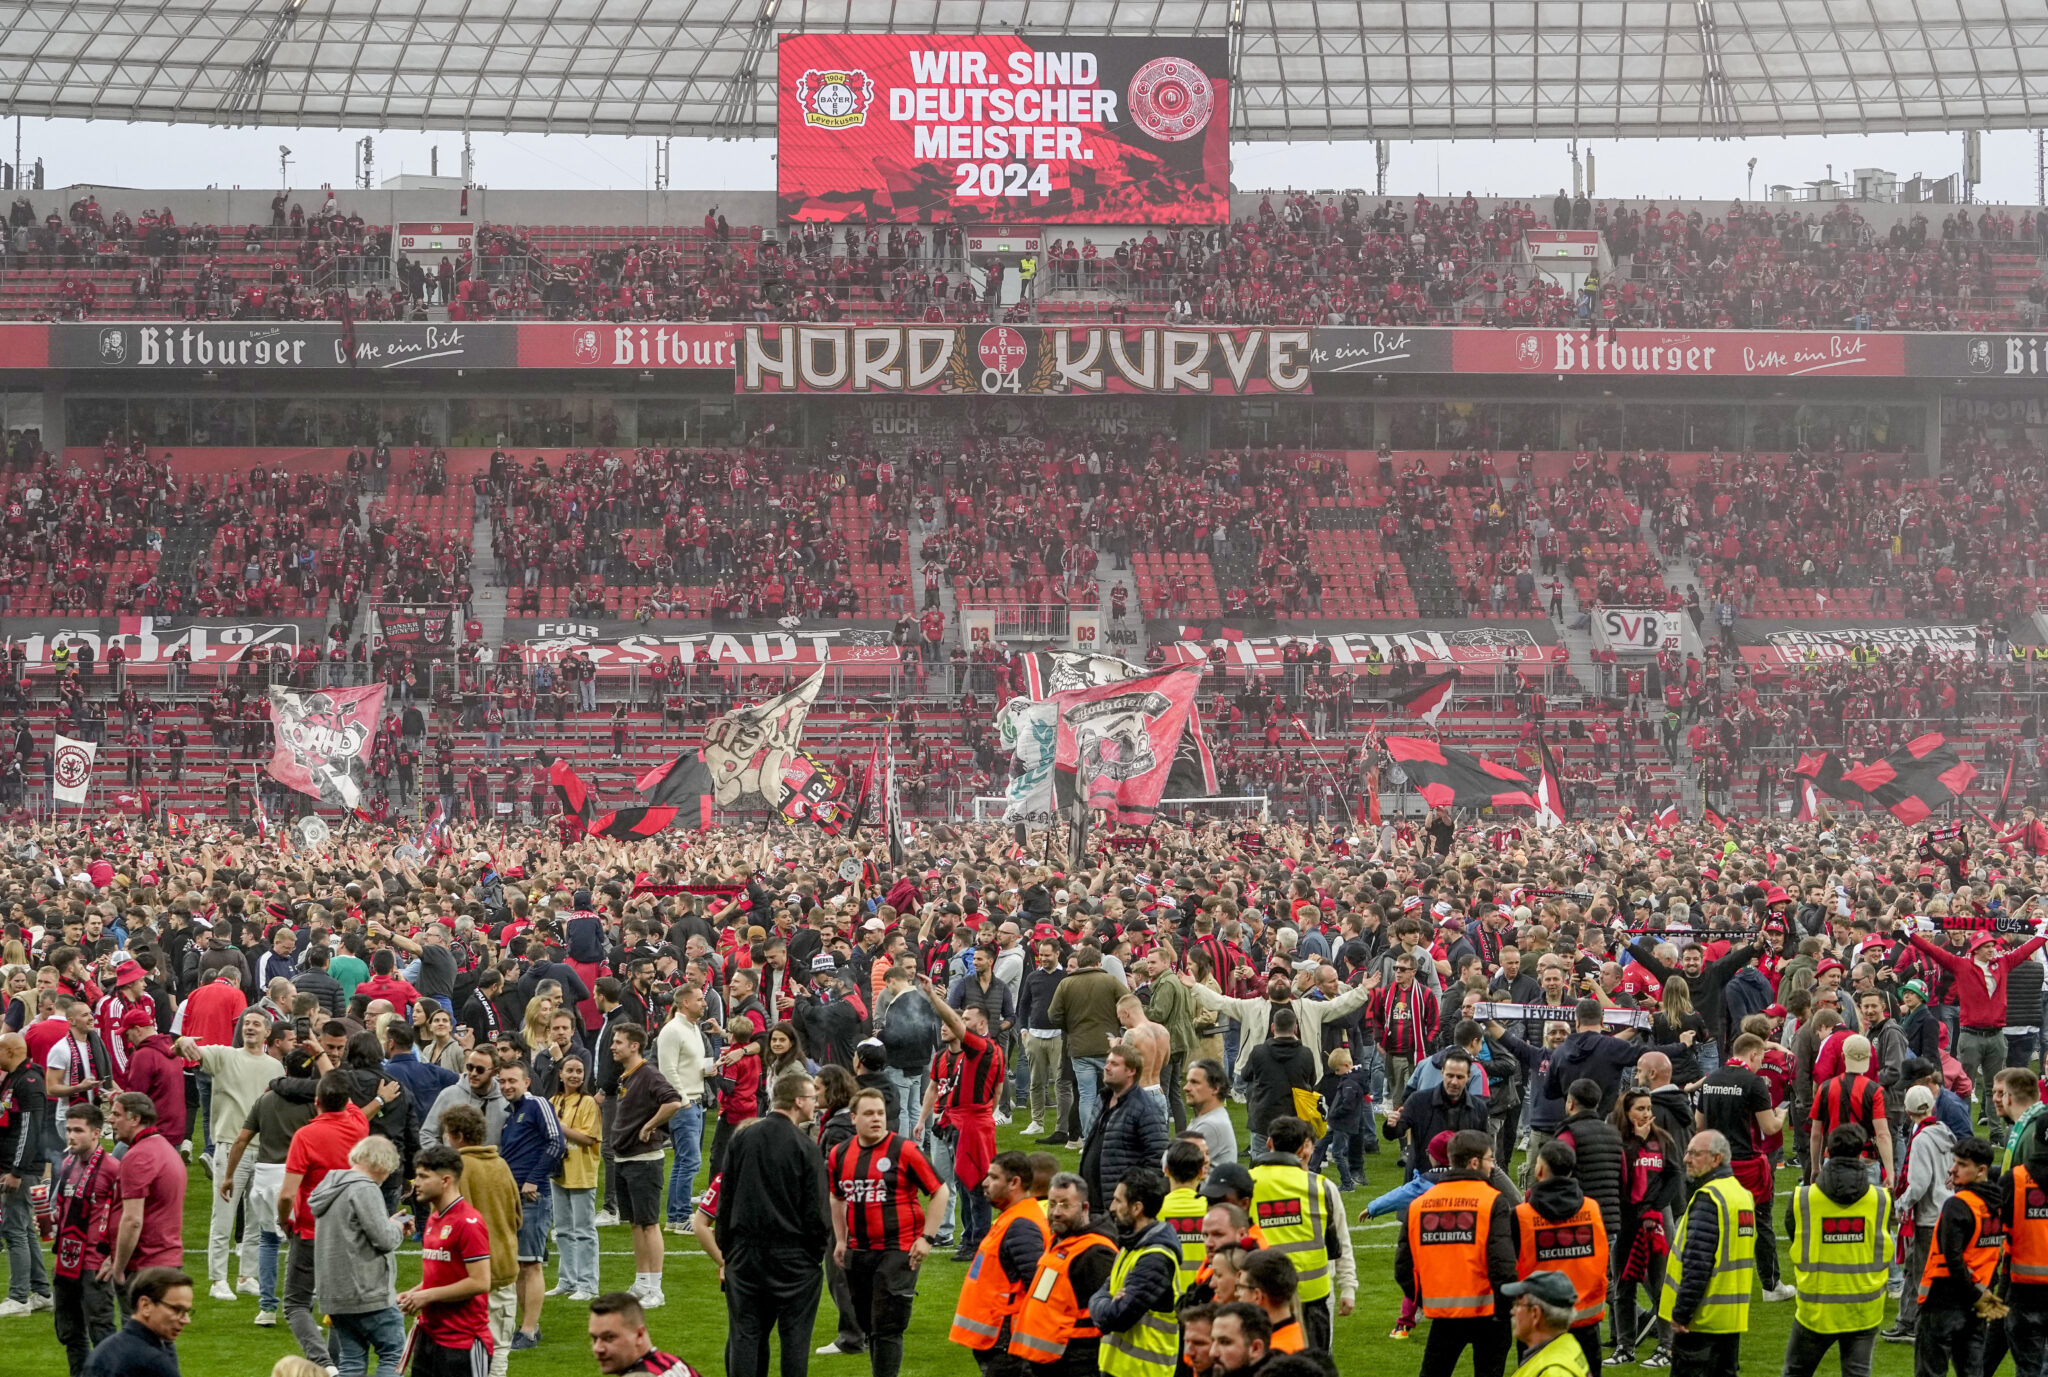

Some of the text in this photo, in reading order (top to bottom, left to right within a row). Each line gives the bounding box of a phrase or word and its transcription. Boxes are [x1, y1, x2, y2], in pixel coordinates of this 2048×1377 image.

[909, 50, 1098, 86] WIR. SIND
[889, 87, 1118, 123] DEUTSCHER
[811, 115, 859, 126] Leverkusen
[913, 125, 1095, 160] MEISTER.
[955, 162, 1052, 197] 2024
[402, 237, 414, 247] D9
[970, 239, 982, 249] D8
[1026, 240, 1038, 250] D8
[1583, 245, 1595, 255] D7
[137, 327, 306, 365] Bitburger
[387, 339, 423, 355] ein
[980, 345, 1026, 355] BAYER
[998, 329, 1008, 372] BAYER
[1335, 344, 1370, 358] ein
[1373, 331, 1410, 353] Bit
[1554, 332, 1717, 371] Bitburger
[742, 325, 957, 391] NORD
[1054, 328, 1310, 392] KURVE
[1744, 336, 1867, 371] Bitte ein Bit
[981, 368, 1022, 393] 04
[872, 418, 919, 434] EUCH
[538, 622, 599, 638] FÜR
[971, 627, 989, 641] D3
[1078, 626, 1095, 641] D3
[1606, 612, 1658, 647] SVB
[618, 631, 841, 664] STADT
[807, 782, 827, 803] 12
[1702, 1083, 1743, 1096] Barmenia
[1421, 1197, 1448, 1209] SECURITY
[1453, 1197, 1479, 1208] SERVICE
[1260, 1215, 1301, 1227] SECURITAS
[1422, 1231, 1473, 1243] SECURITAS
[1823, 1233, 1864, 1243] SECURITAS
[1539, 1244, 1592, 1258] SECURITAS
